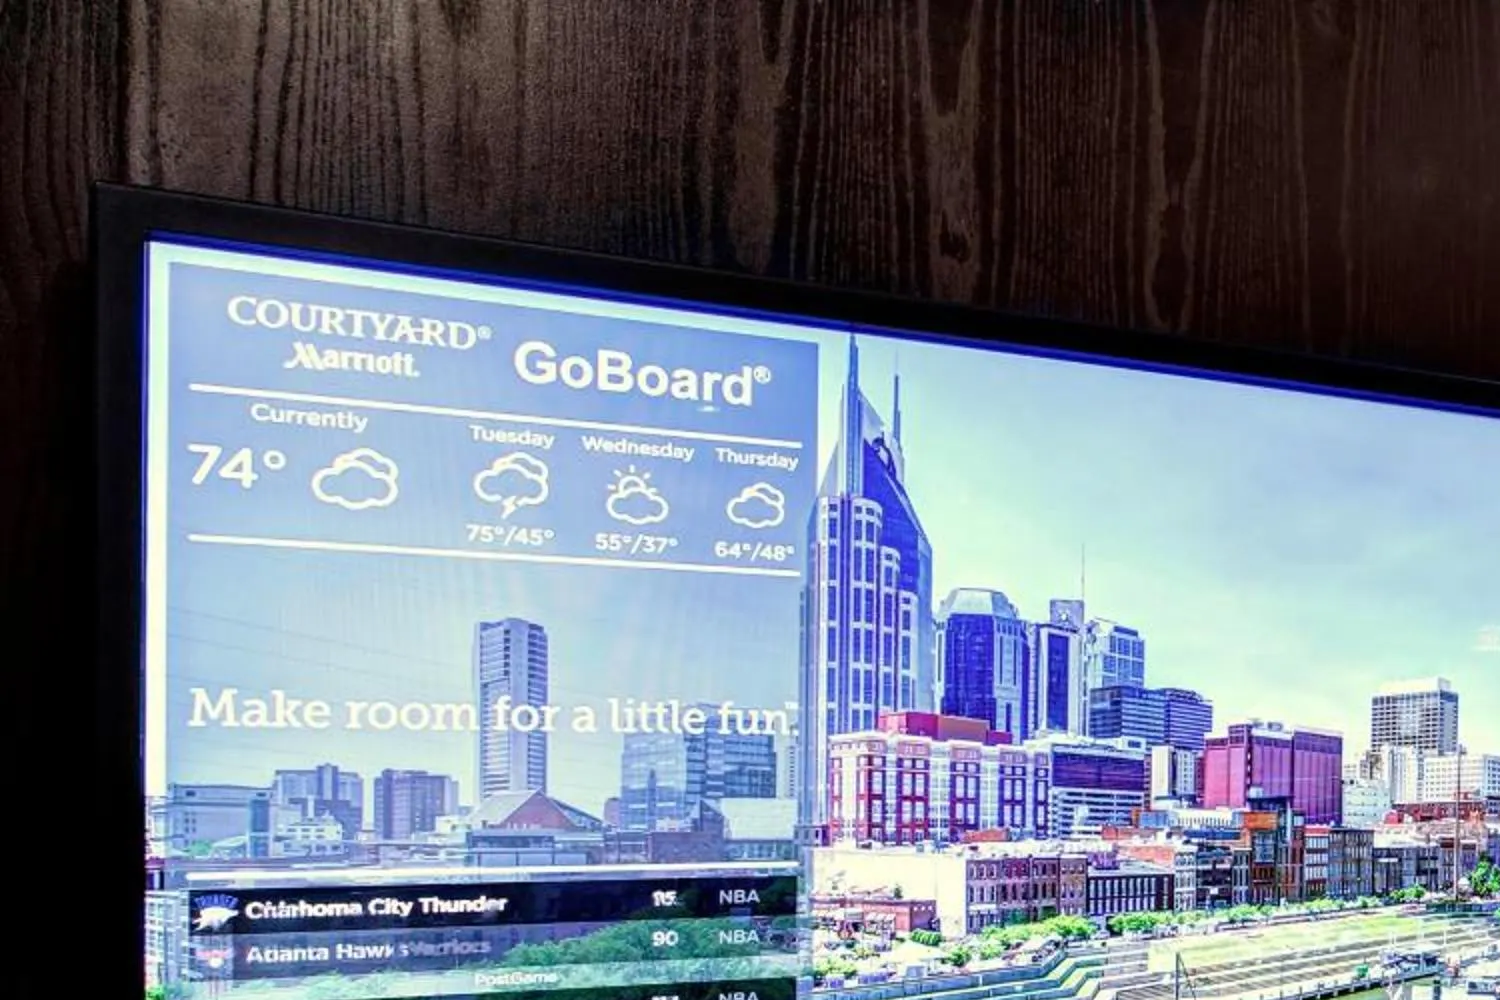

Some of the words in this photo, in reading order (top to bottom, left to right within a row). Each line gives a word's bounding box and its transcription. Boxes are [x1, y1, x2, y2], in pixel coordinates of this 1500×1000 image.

[249, 401, 368, 433] Currently
[469, 424, 555, 450] Tuesday
[580, 434, 695, 463] Wednesday
[714, 447, 799, 472] Thursday
[187, 686, 332, 731] Make
[345, 699, 480, 732] room
[491, 695, 560, 733] for
[571, 705, 598, 734] a
[609, 696, 706, 735] little
[367, 898, 413, 917] City
[417, 896, 508, 913] Thunder
[718, 888, 761, 904] NBA
[652, 930, 679, 947] 90
[718, 929, 760, 944] NBA
